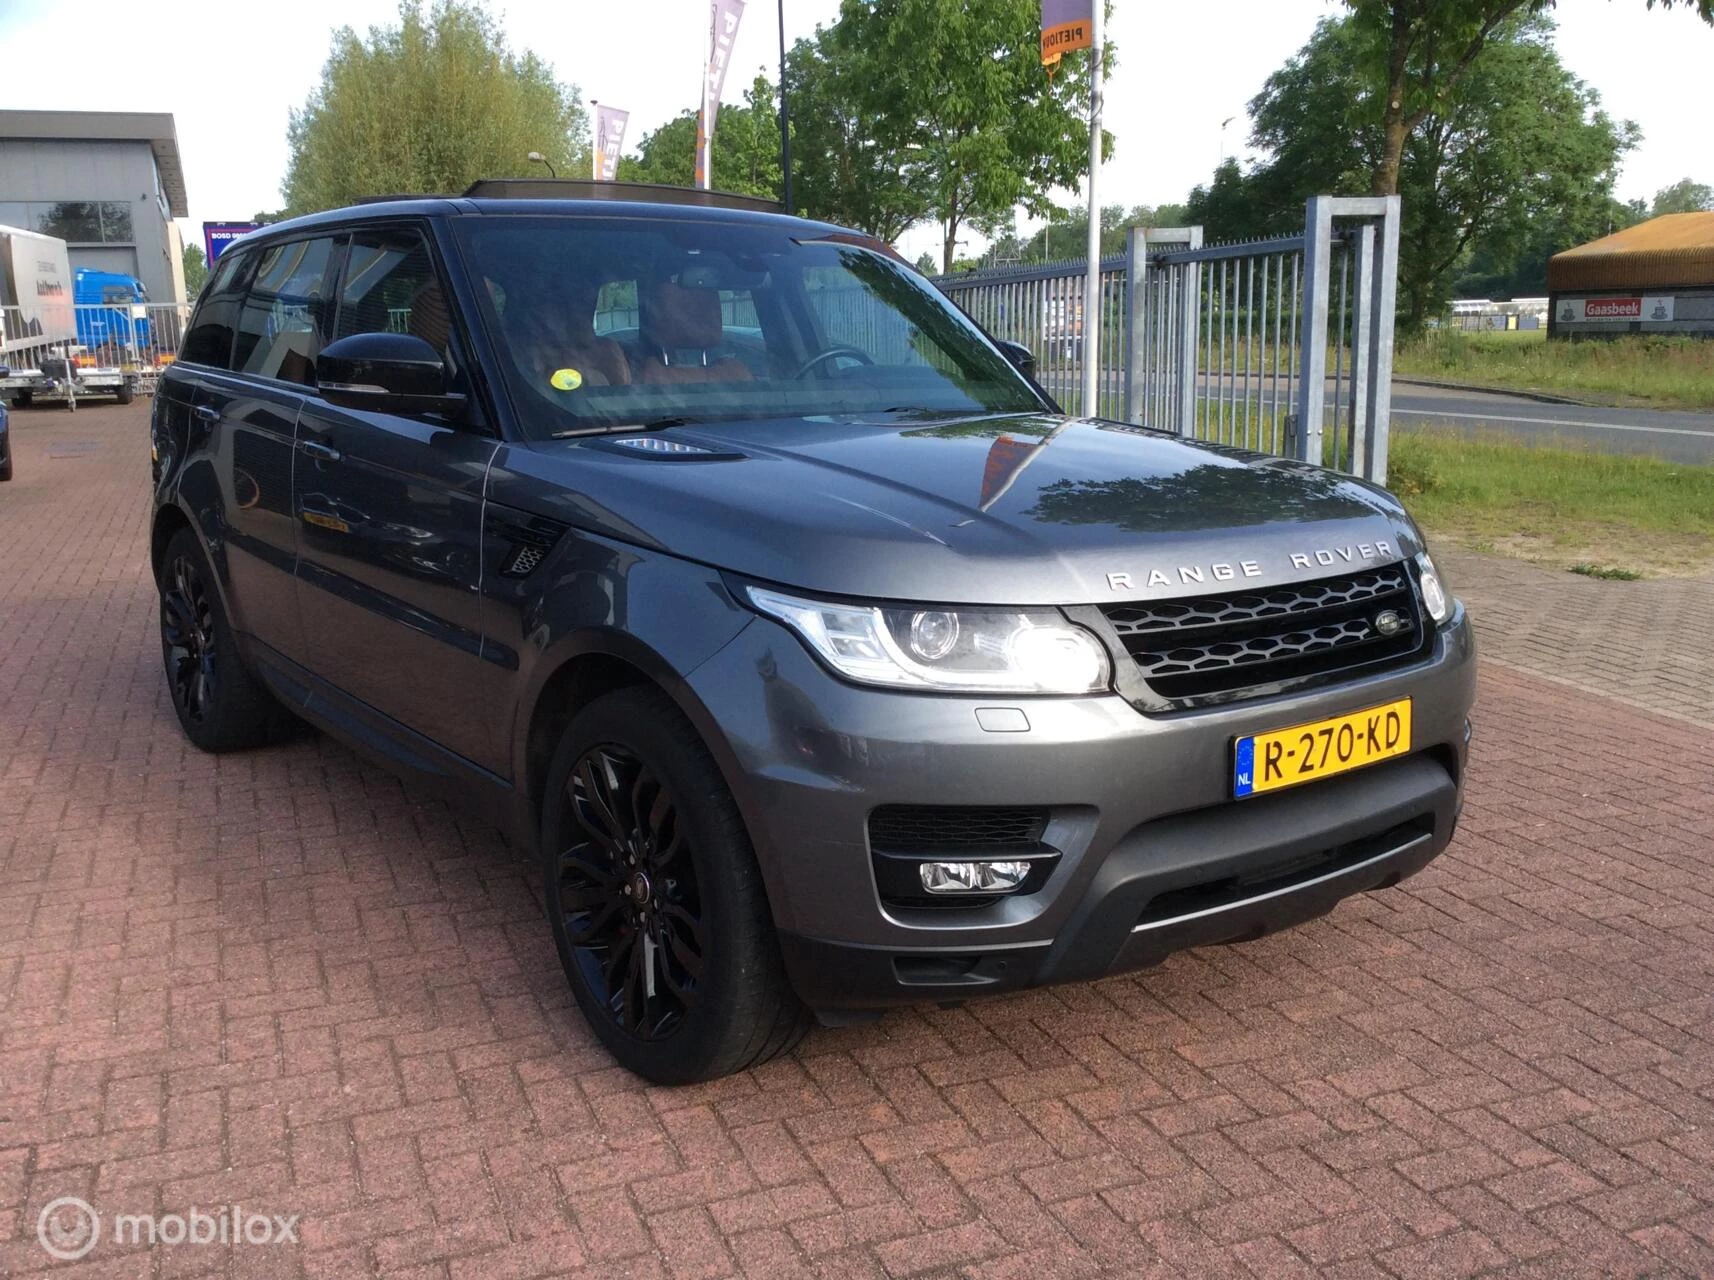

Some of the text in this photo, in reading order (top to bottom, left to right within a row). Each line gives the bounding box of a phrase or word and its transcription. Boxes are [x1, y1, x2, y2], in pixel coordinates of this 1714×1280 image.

[1586, 302, 1639, 315] Gaasbeek
[1106, 541, 1393, 591] RANGE ROVER
[1264, 711, 1401, 782] R-270-KD
[1238, 773, 1251, 787] NL
